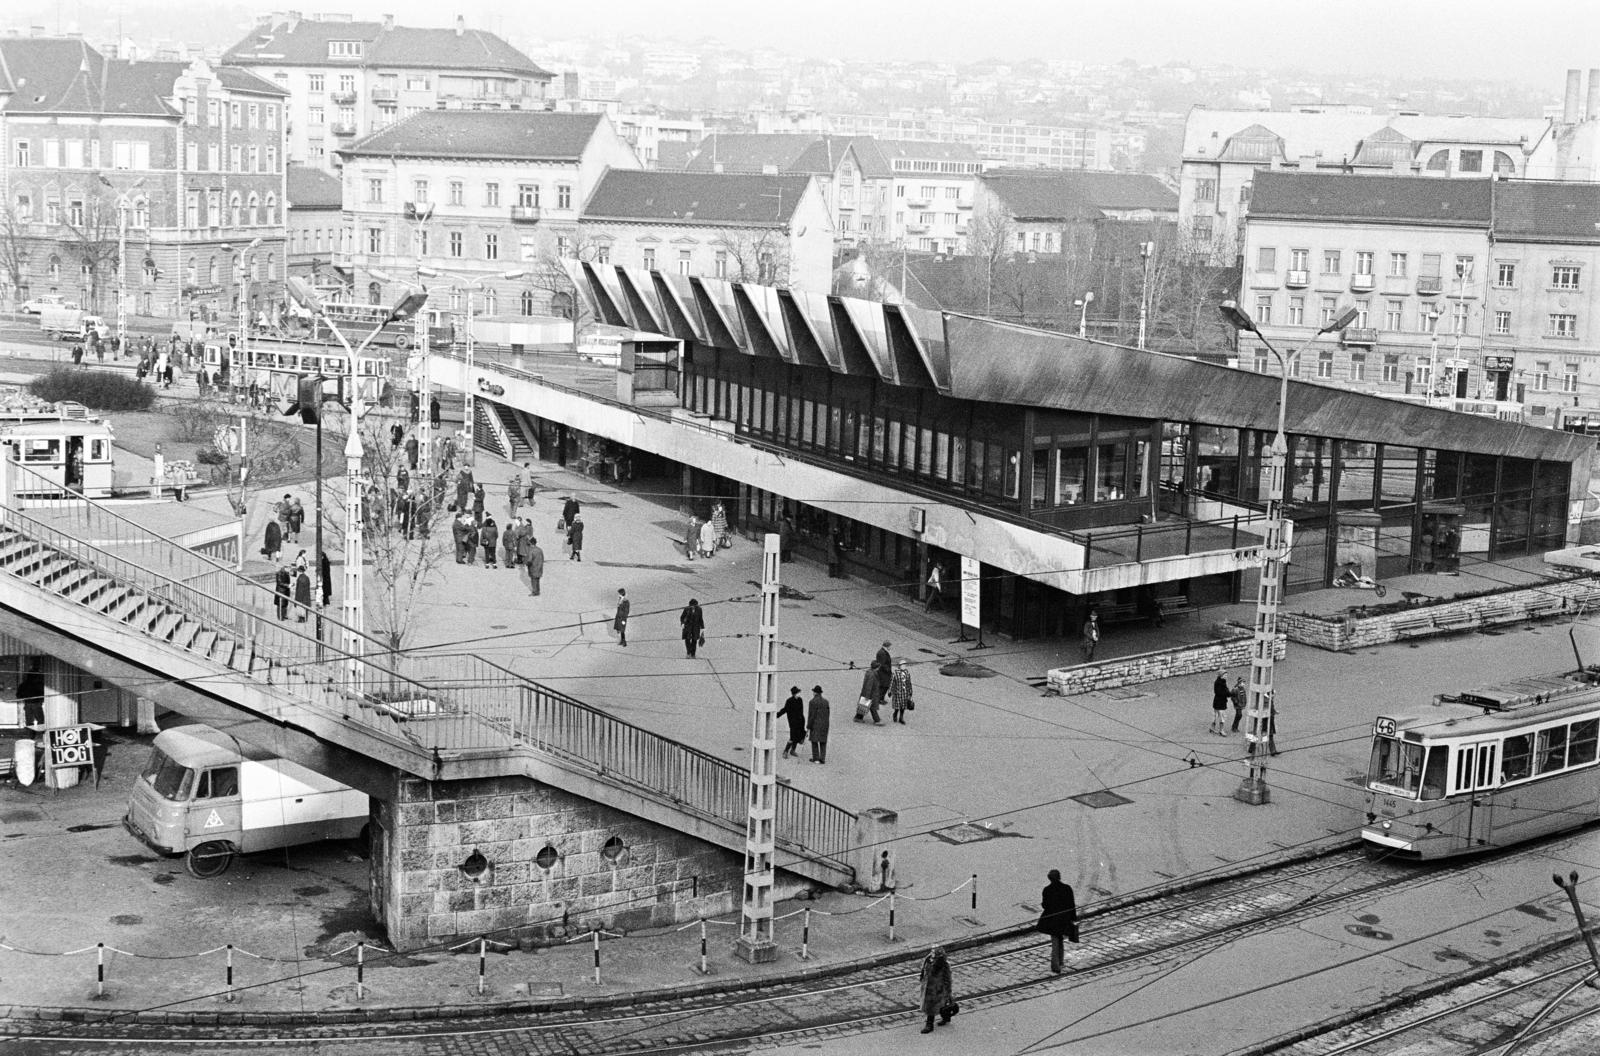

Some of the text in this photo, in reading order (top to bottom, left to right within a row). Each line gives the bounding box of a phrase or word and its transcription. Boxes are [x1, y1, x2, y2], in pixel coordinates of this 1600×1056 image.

[1378, 719, 1394, 734] 4-6
[55, 729, 82, 746] HOT
[56, 746, 87, 764] DOG
